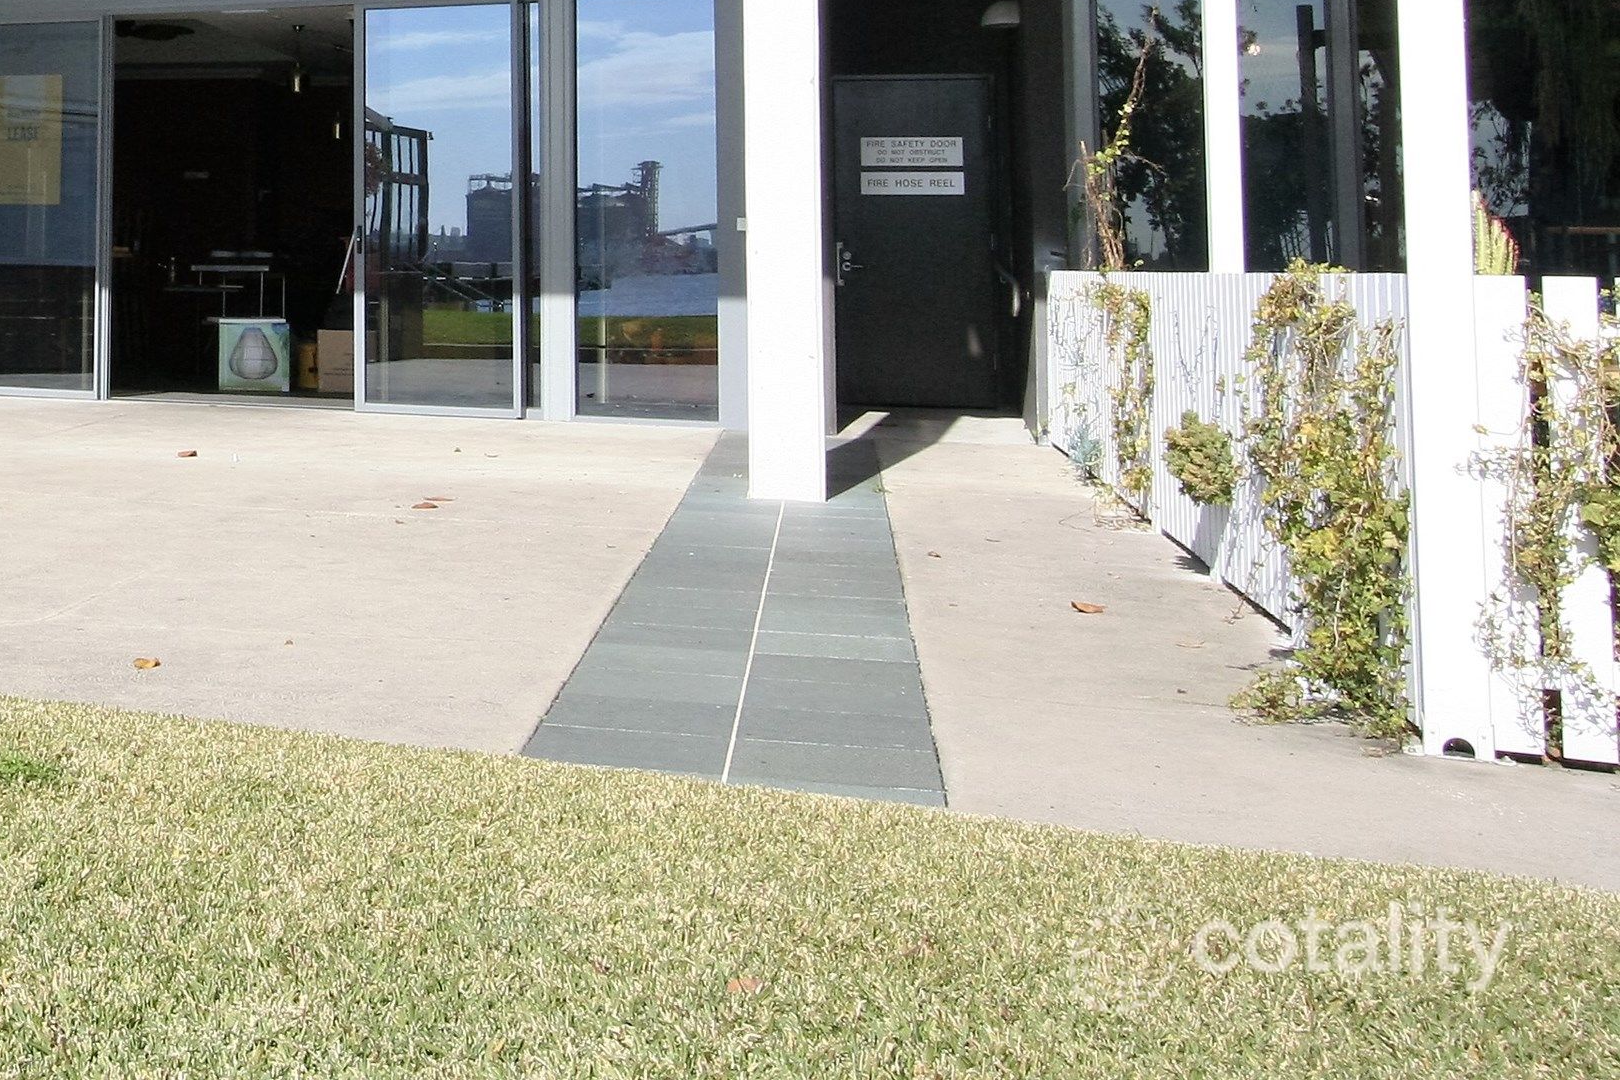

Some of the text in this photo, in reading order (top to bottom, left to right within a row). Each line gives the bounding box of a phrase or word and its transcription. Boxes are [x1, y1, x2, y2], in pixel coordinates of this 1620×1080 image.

[866, 140, 957, 148] FIRE SAFETY DOOR
[867, 179, 956, 188] FIRE HOSE REEL
